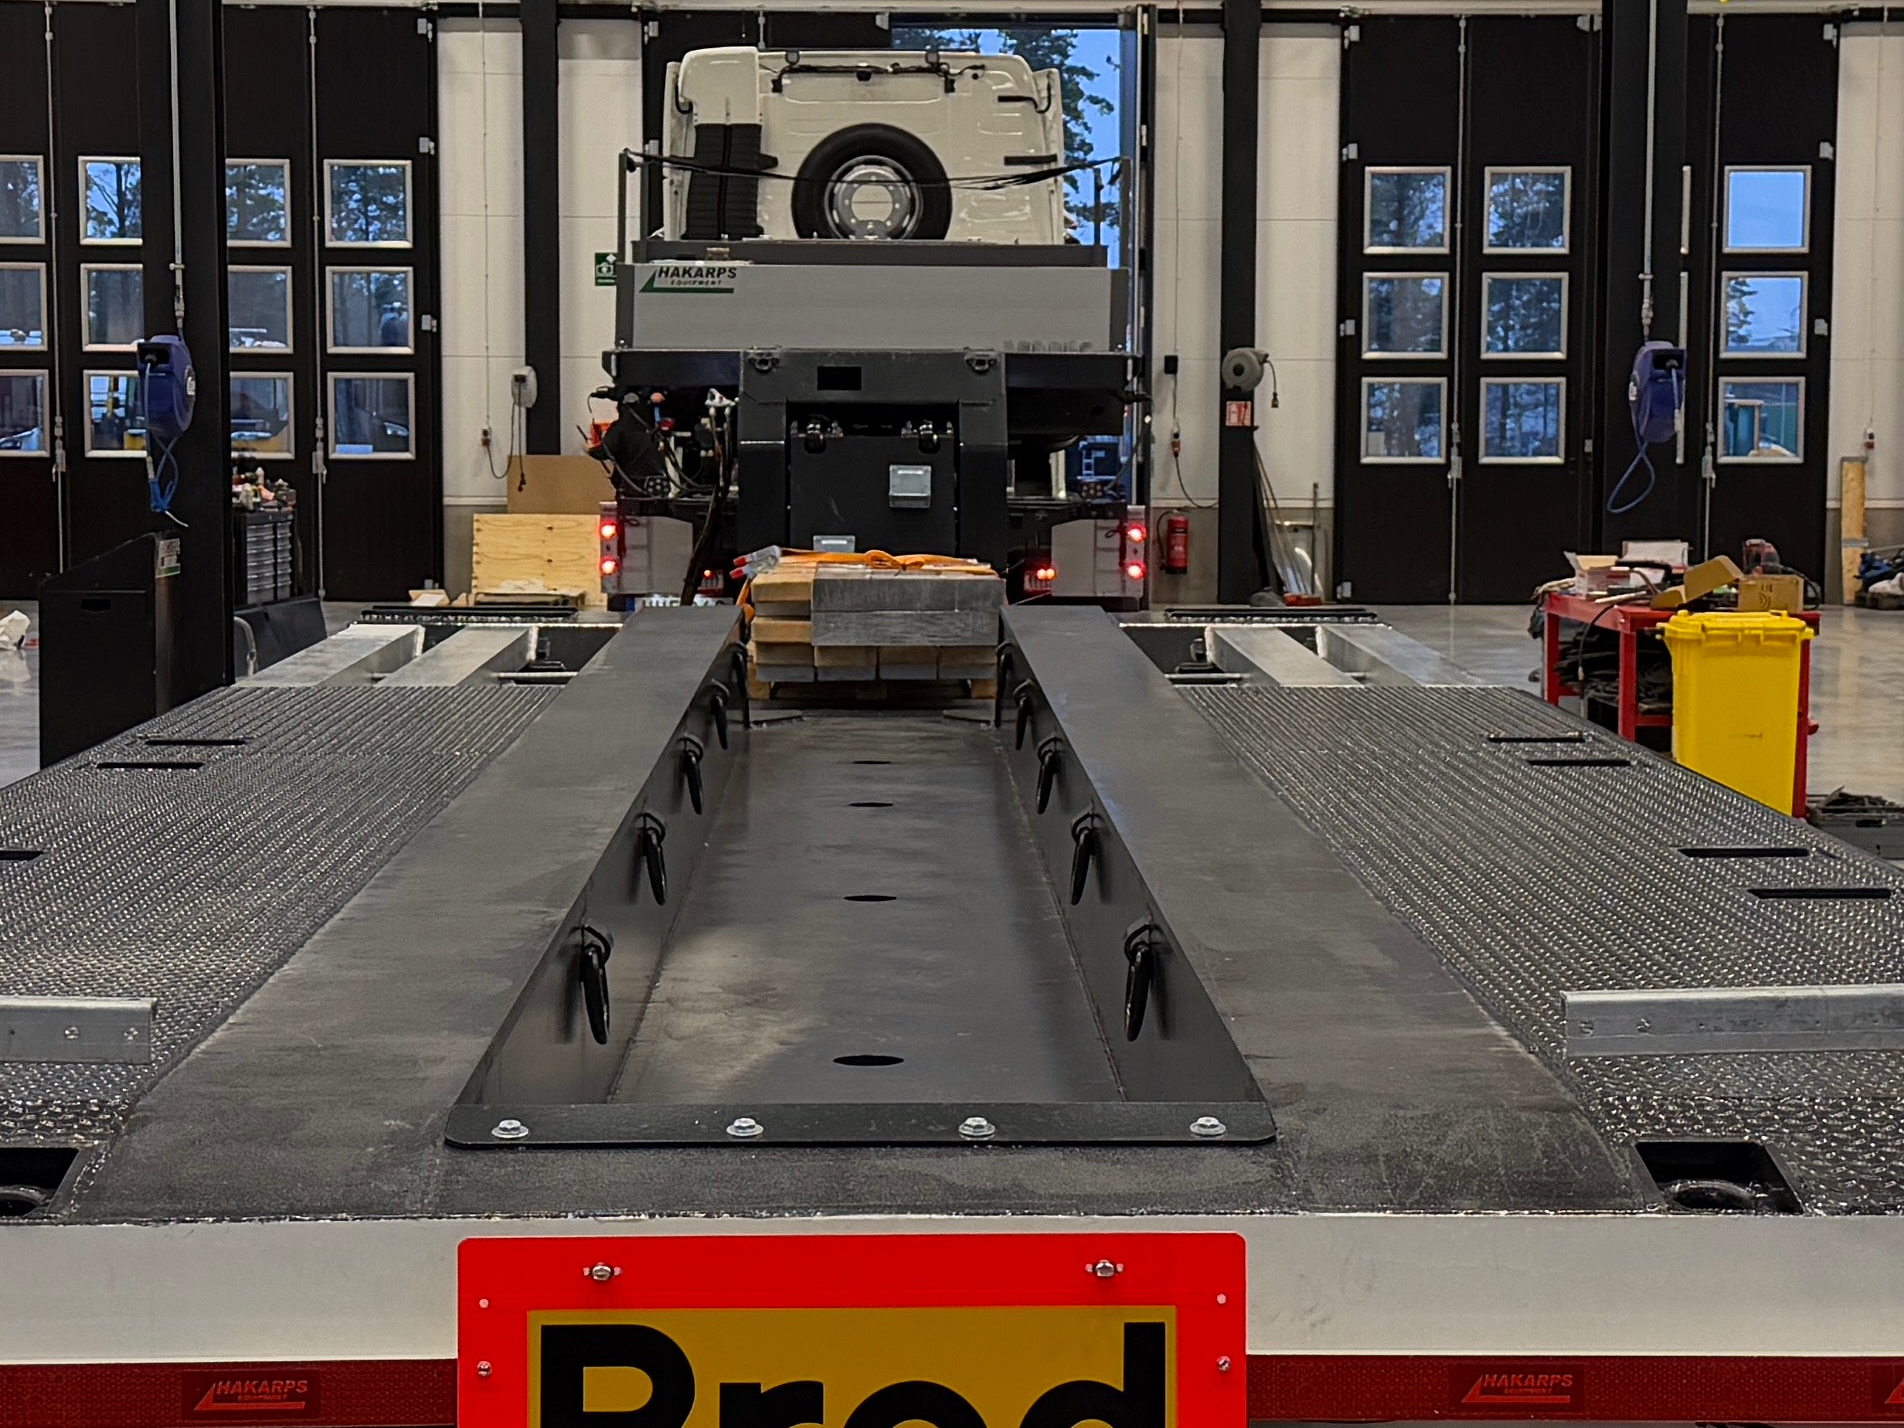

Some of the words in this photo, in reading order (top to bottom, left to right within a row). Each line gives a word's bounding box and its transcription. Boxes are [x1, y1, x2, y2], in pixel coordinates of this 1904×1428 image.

[657, 266, 737, 279] HAKARPS
[216, 1380, 308, 1395] HAKARPS
[1483, 1374, 1574, 1388] HAKARPS
